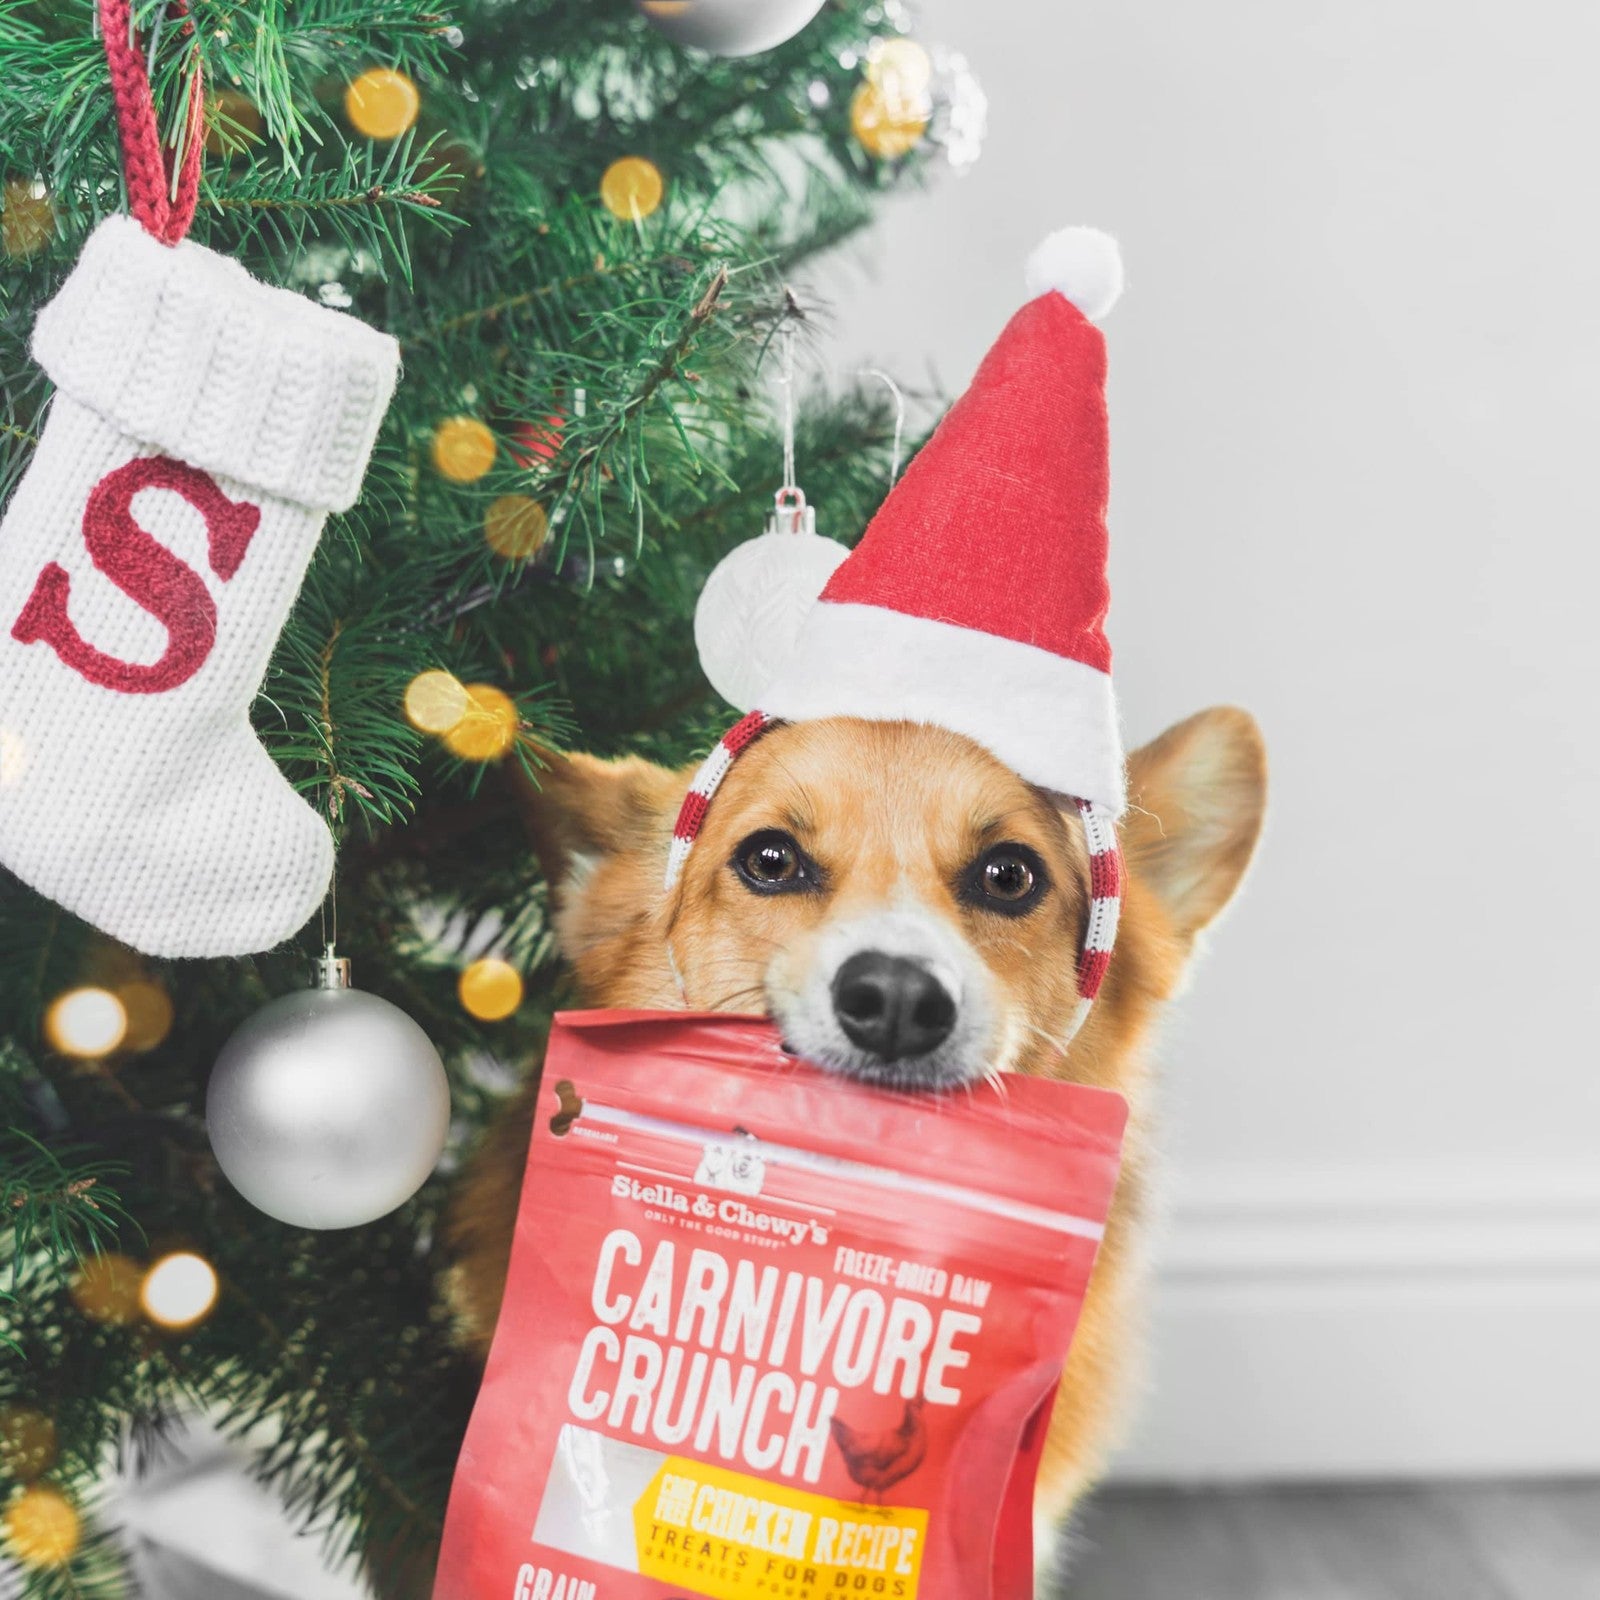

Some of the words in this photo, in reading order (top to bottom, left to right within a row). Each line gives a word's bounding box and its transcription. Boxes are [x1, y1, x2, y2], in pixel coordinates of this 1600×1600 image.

[11, 455, 261, 694] S
[610, 1175, 689, 1213] Stella
[692, 1193, 715, 1219] &
[719, 1199, 829, 1246] Chewy's
[644, 1210, 675, 1226] ONLY
[679, 1217, 701, 1231] THE
[705, 1224, 740, 1240] GOOD
[591, 1228, 982, 1406] CARNIVORE
[833, 1245, 948, 1299] FREEZE-DRIED
[949, 1274, 992, 1309] RAW
[567, 1326, 840, 1484] CRUNCH
[650, 1525, 749, 1567] TREATS
[765, 1558, 817, 1585] FOR
[835, 1572, 907, 1597] DOGS
[690, 1483, 813, 1559] CHICKEN
[813, 1517, 917, 1575] RECIPE
